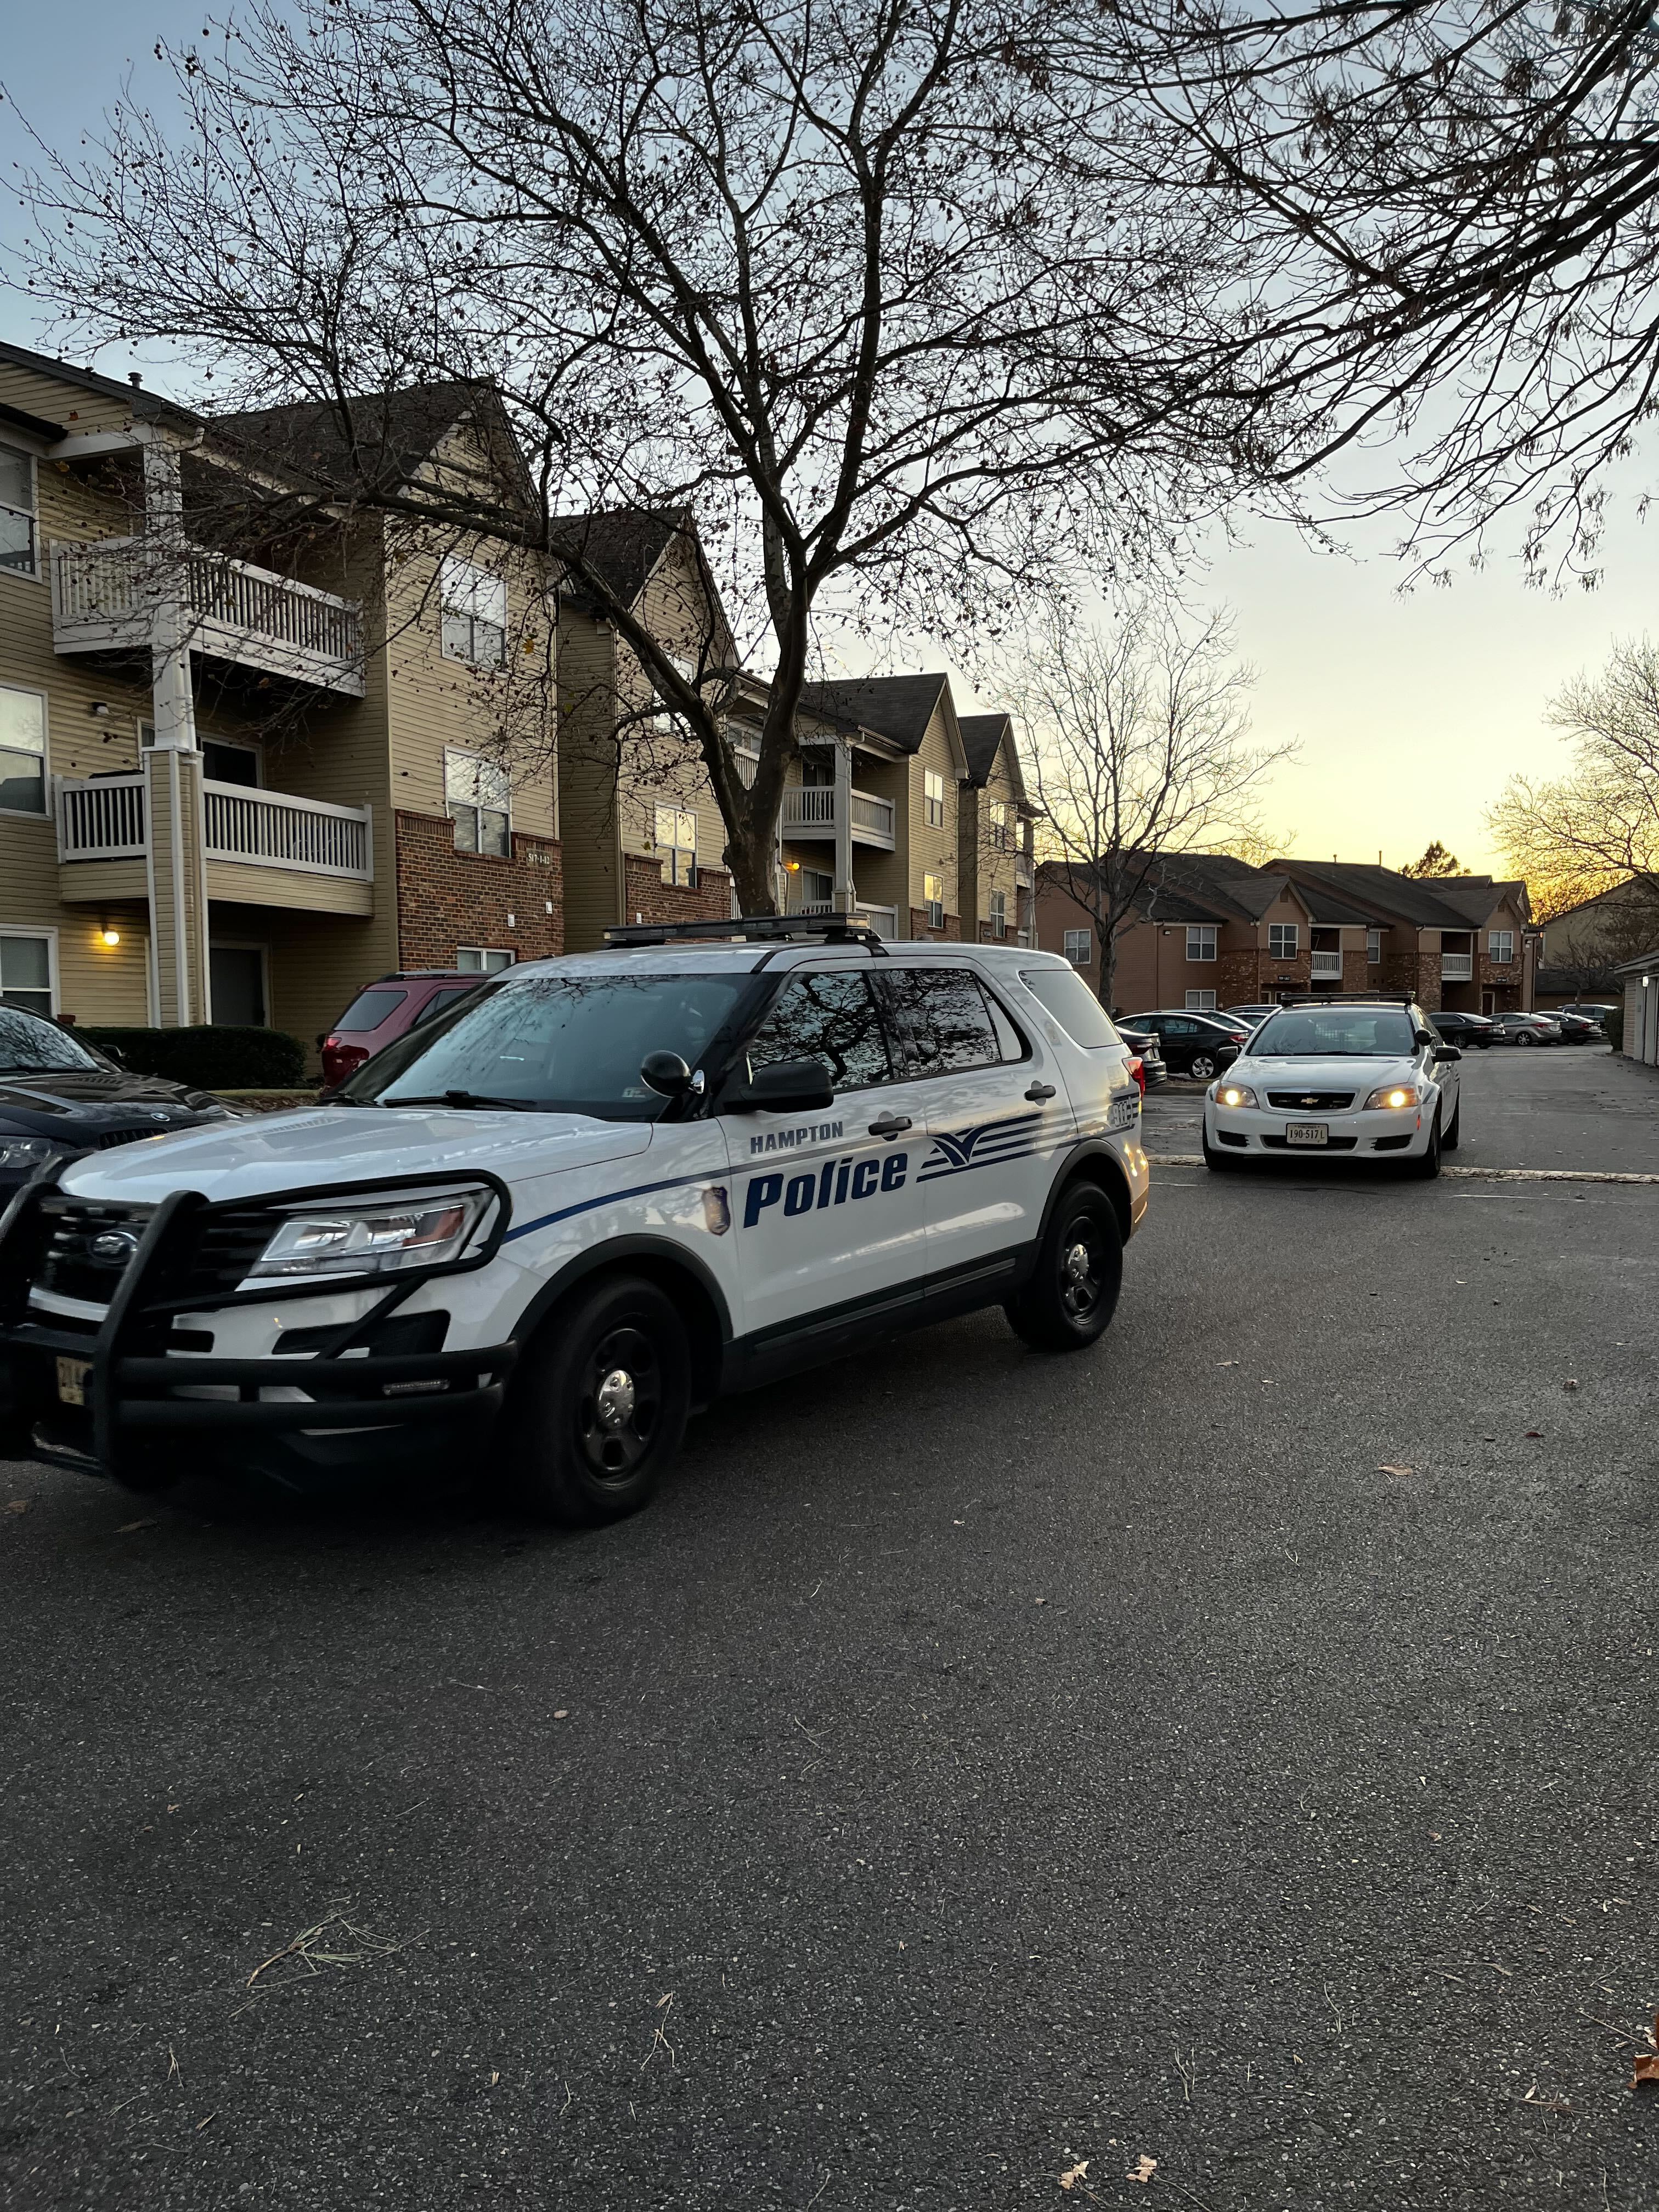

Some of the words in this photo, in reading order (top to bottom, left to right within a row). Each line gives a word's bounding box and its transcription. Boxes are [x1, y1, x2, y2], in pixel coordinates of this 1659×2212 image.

[751, 1121, 843, 1154] HAMPTON
[1290, 1130, 1324, 1139] 190-517L
[743, 1153, 907, 1228] Police
